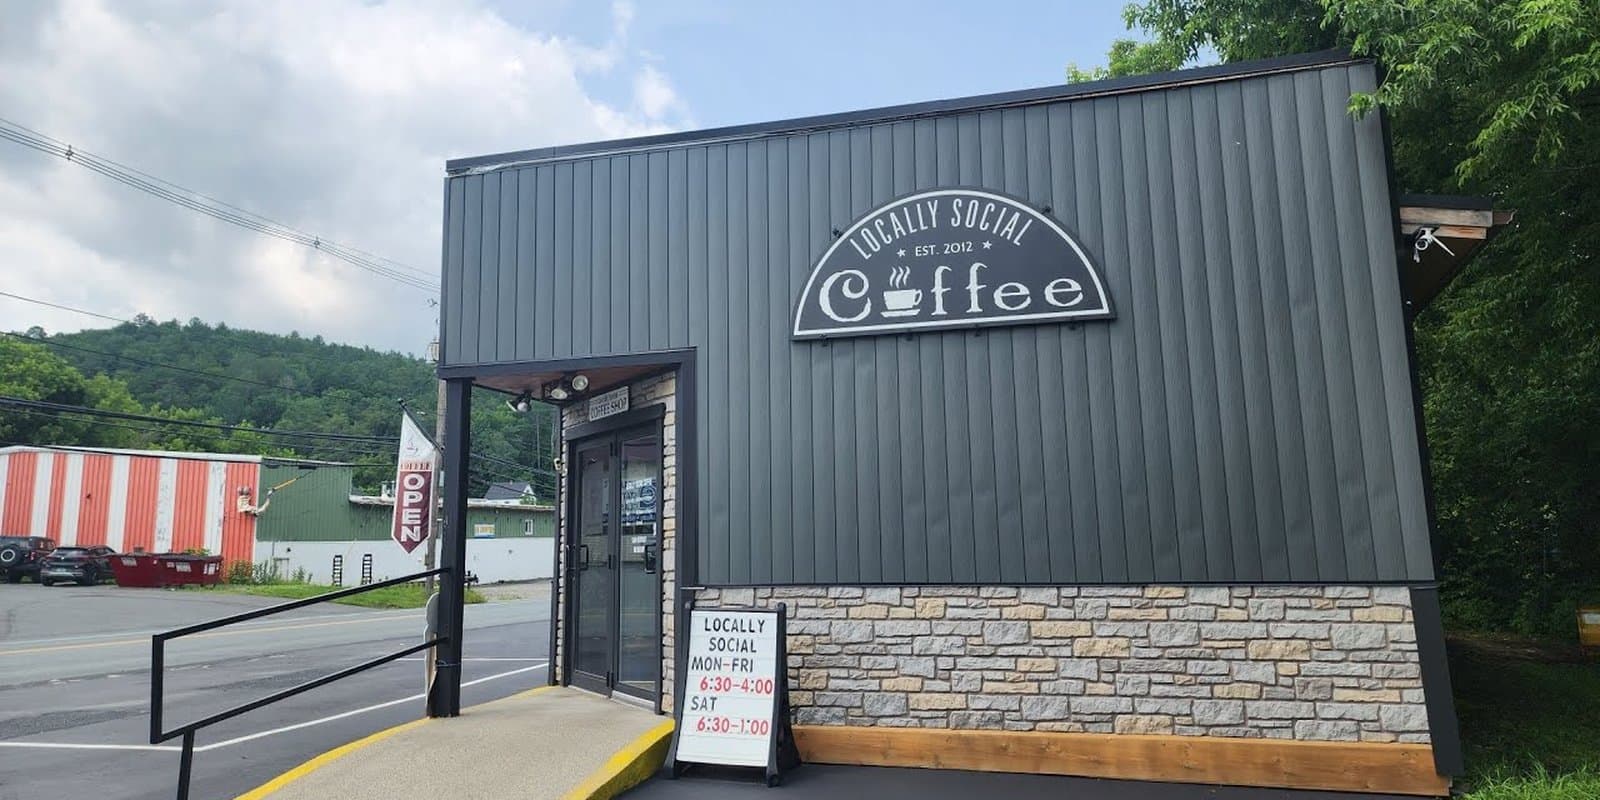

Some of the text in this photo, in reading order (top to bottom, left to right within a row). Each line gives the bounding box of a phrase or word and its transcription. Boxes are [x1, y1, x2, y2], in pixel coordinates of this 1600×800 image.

[850, 198, 1033, 260] LOCALLY SOCIAL
[915, 241, 973, 257] EST. 2012
[819, 262, 1083, 323] Cffee
[611, 397, 627, 413] SHOP
[400, 473, 425, 543] OPEN
[704, 617, 765, 633] LOCALLY
[709, 637, 757, 653] SOCIAL
[691, 656, 753, 673] MON-FRI
[700, 676, 773, 695] 6:30-4:00
[691, 696, 717, 711] SAT
[697, 717, 769, 736] 6:30-1:00
